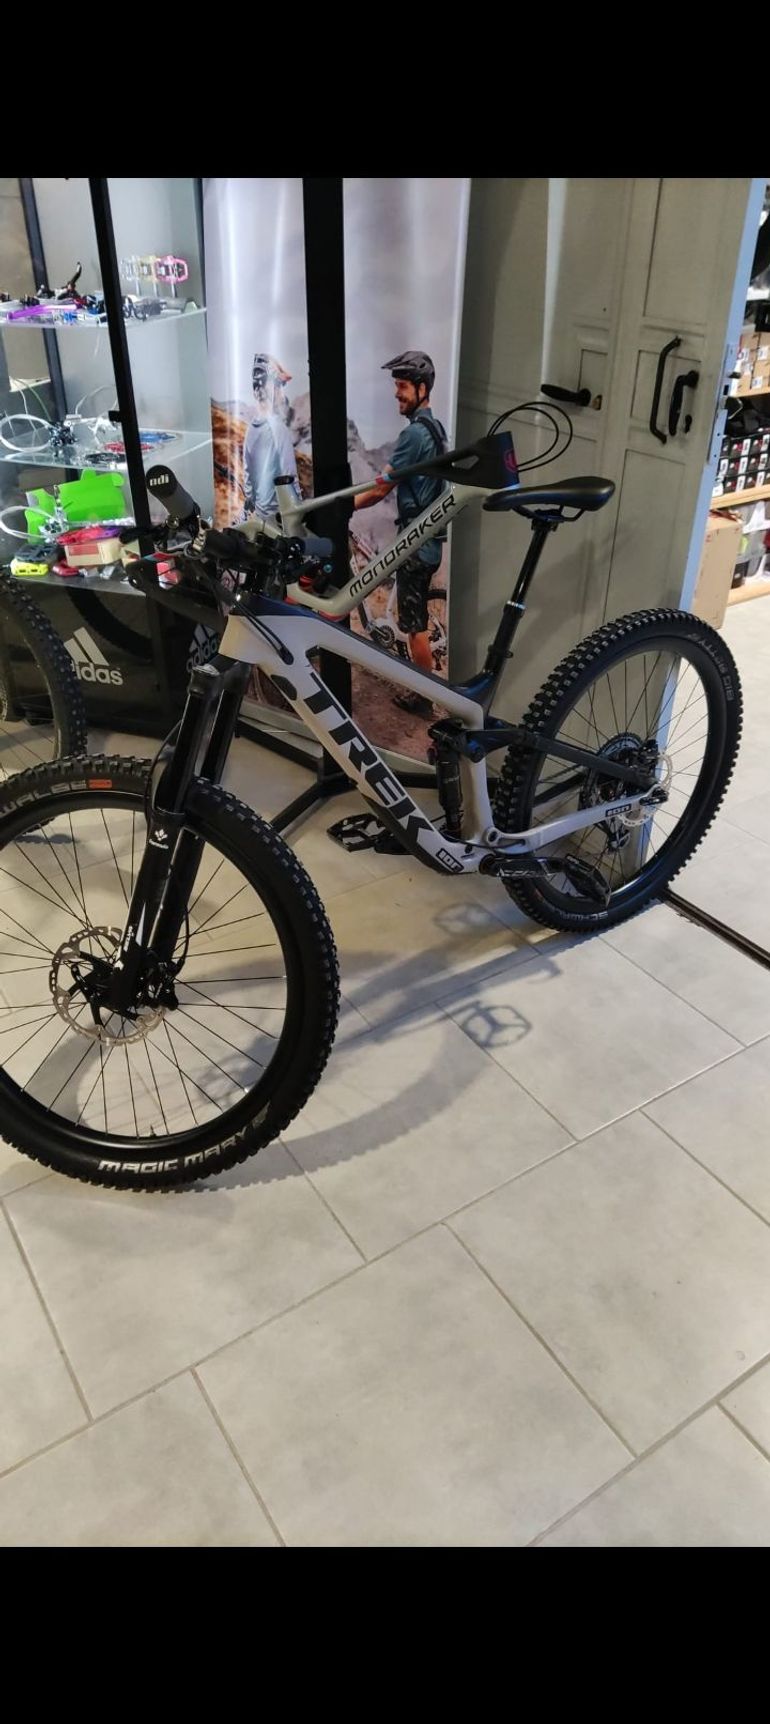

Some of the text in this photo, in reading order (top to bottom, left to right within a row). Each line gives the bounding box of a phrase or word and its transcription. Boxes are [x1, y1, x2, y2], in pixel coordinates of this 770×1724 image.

[303, 672, 434, 850] TREK
[99, 1126, 247, 1174] MAGIC MARY
